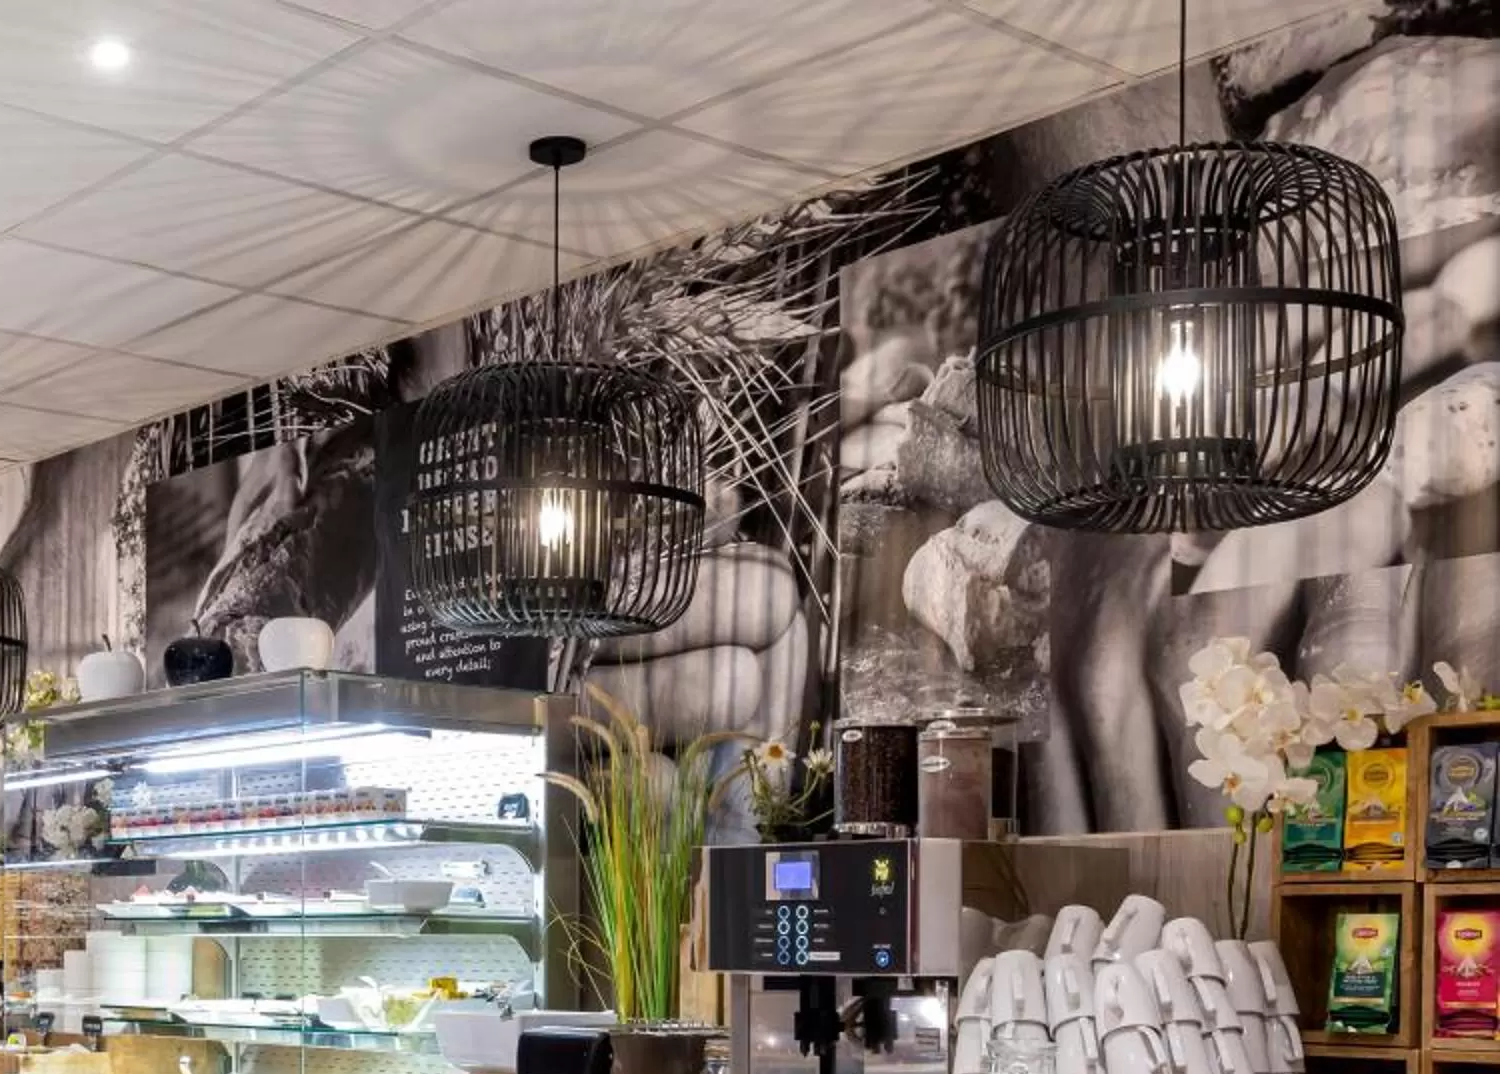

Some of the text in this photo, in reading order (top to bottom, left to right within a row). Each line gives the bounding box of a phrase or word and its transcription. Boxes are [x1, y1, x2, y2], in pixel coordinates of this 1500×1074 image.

[405, 631, 437, 656] proud
[415, 638, 502, 664] and attention to
[424, 665, 454, 681] every
